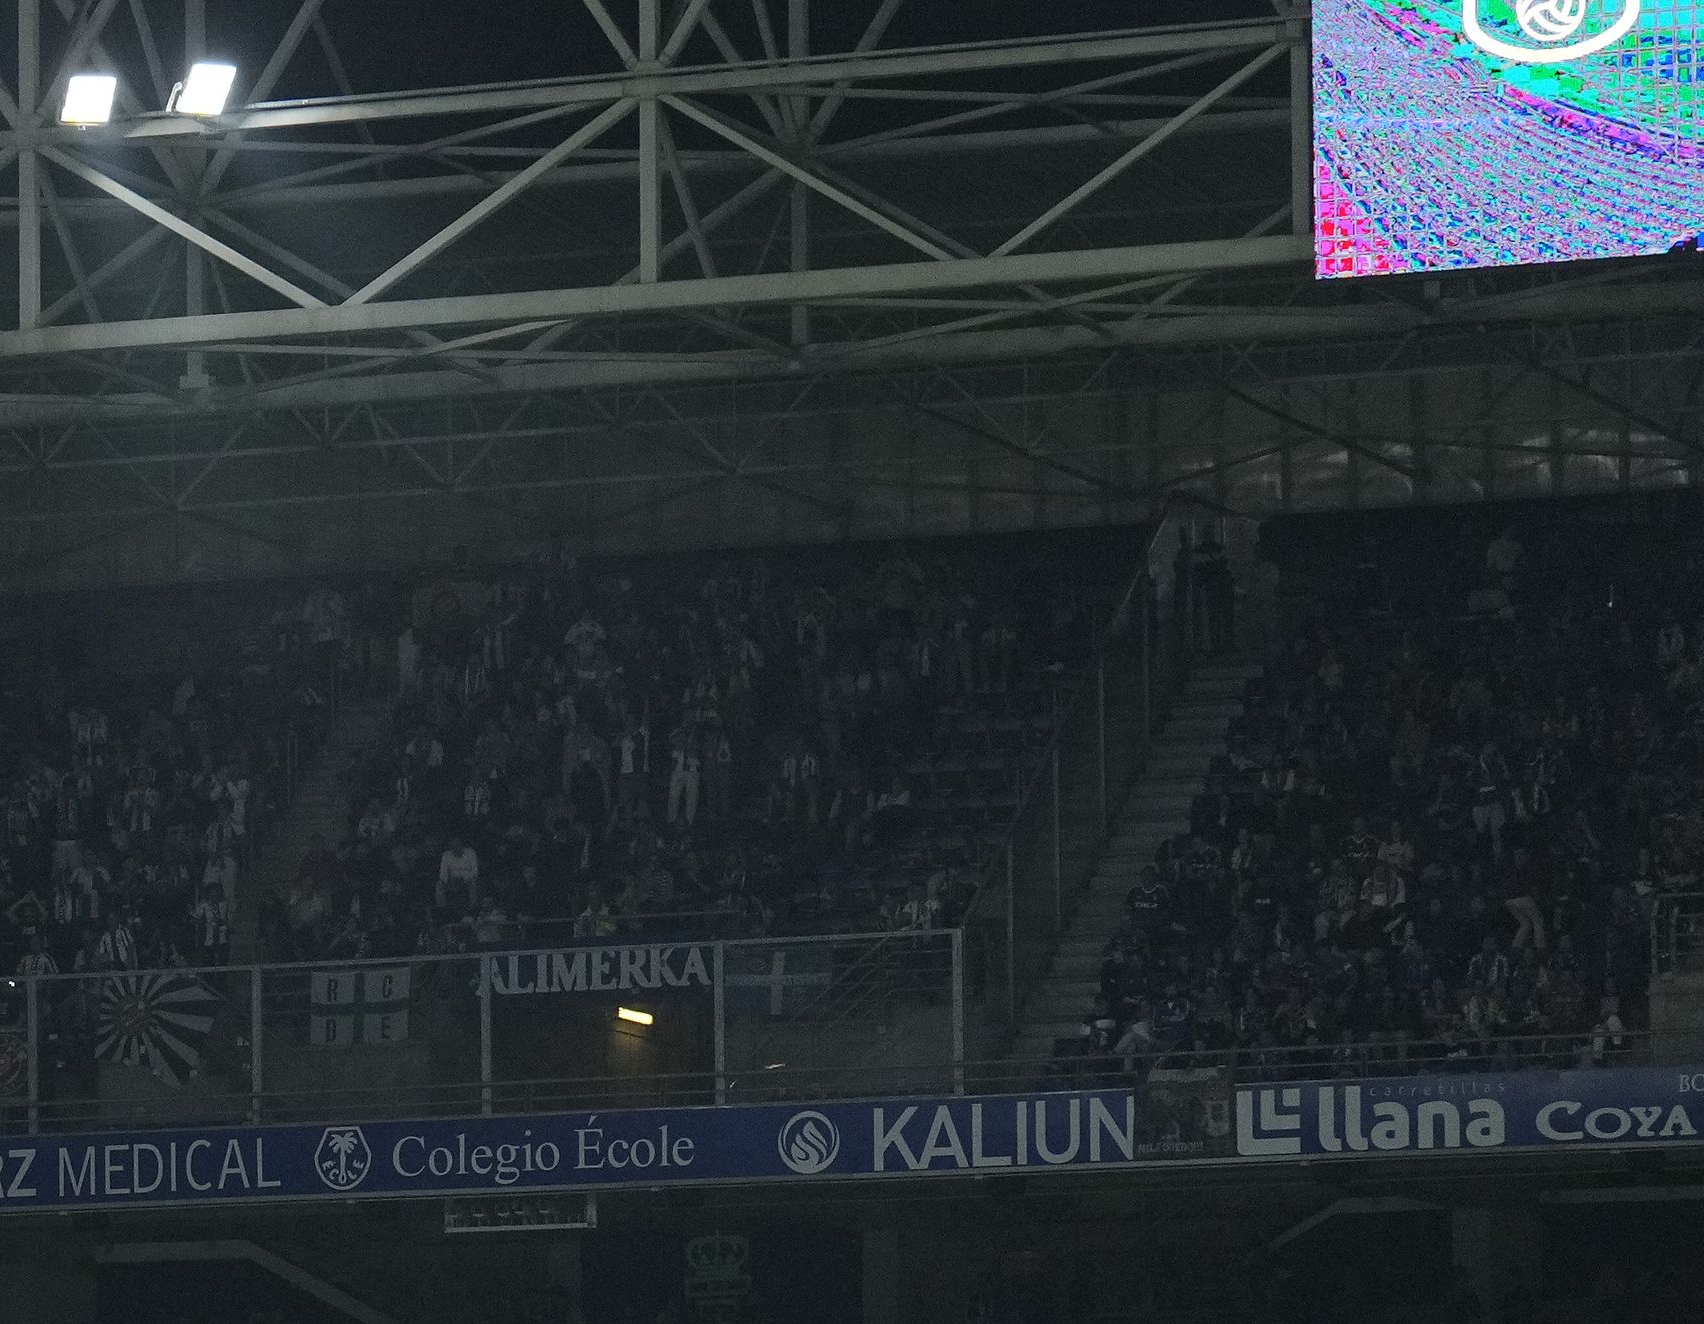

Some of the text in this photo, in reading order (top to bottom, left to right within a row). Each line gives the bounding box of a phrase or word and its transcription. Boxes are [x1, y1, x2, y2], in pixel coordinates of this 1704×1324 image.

[393, 1116, 695, 1185] Colegio École
[872, 1096, 1135, 1173] KALIUN
[1317, 1084, 1506, 1152] llana
[58, 1136, 282, 1200] MEDICAL
